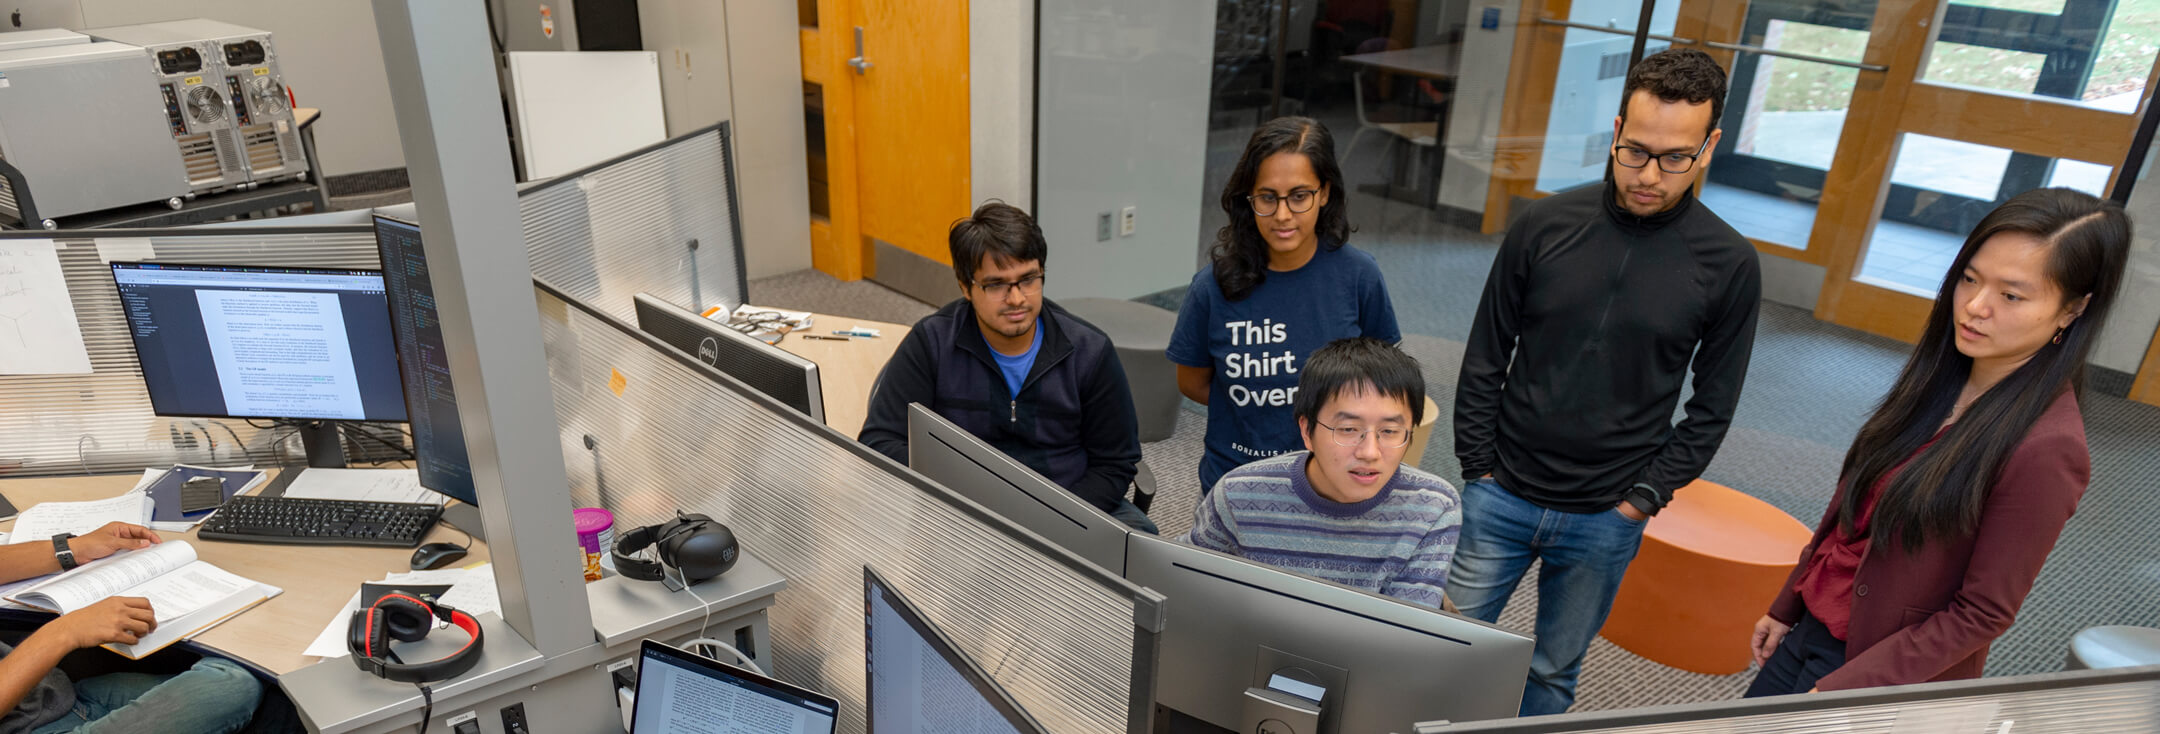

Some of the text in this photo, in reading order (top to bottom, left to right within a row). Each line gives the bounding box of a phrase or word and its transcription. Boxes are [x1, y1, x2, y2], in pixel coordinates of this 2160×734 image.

[1226, 318, 1287, 346] This
[701, 346, 715, 359] DELL
[1225, 351, 1298, 378] Shirt
[1229, 384, 1299, 407] Over
[1231, 442, 1279, 457] BOREALIS
